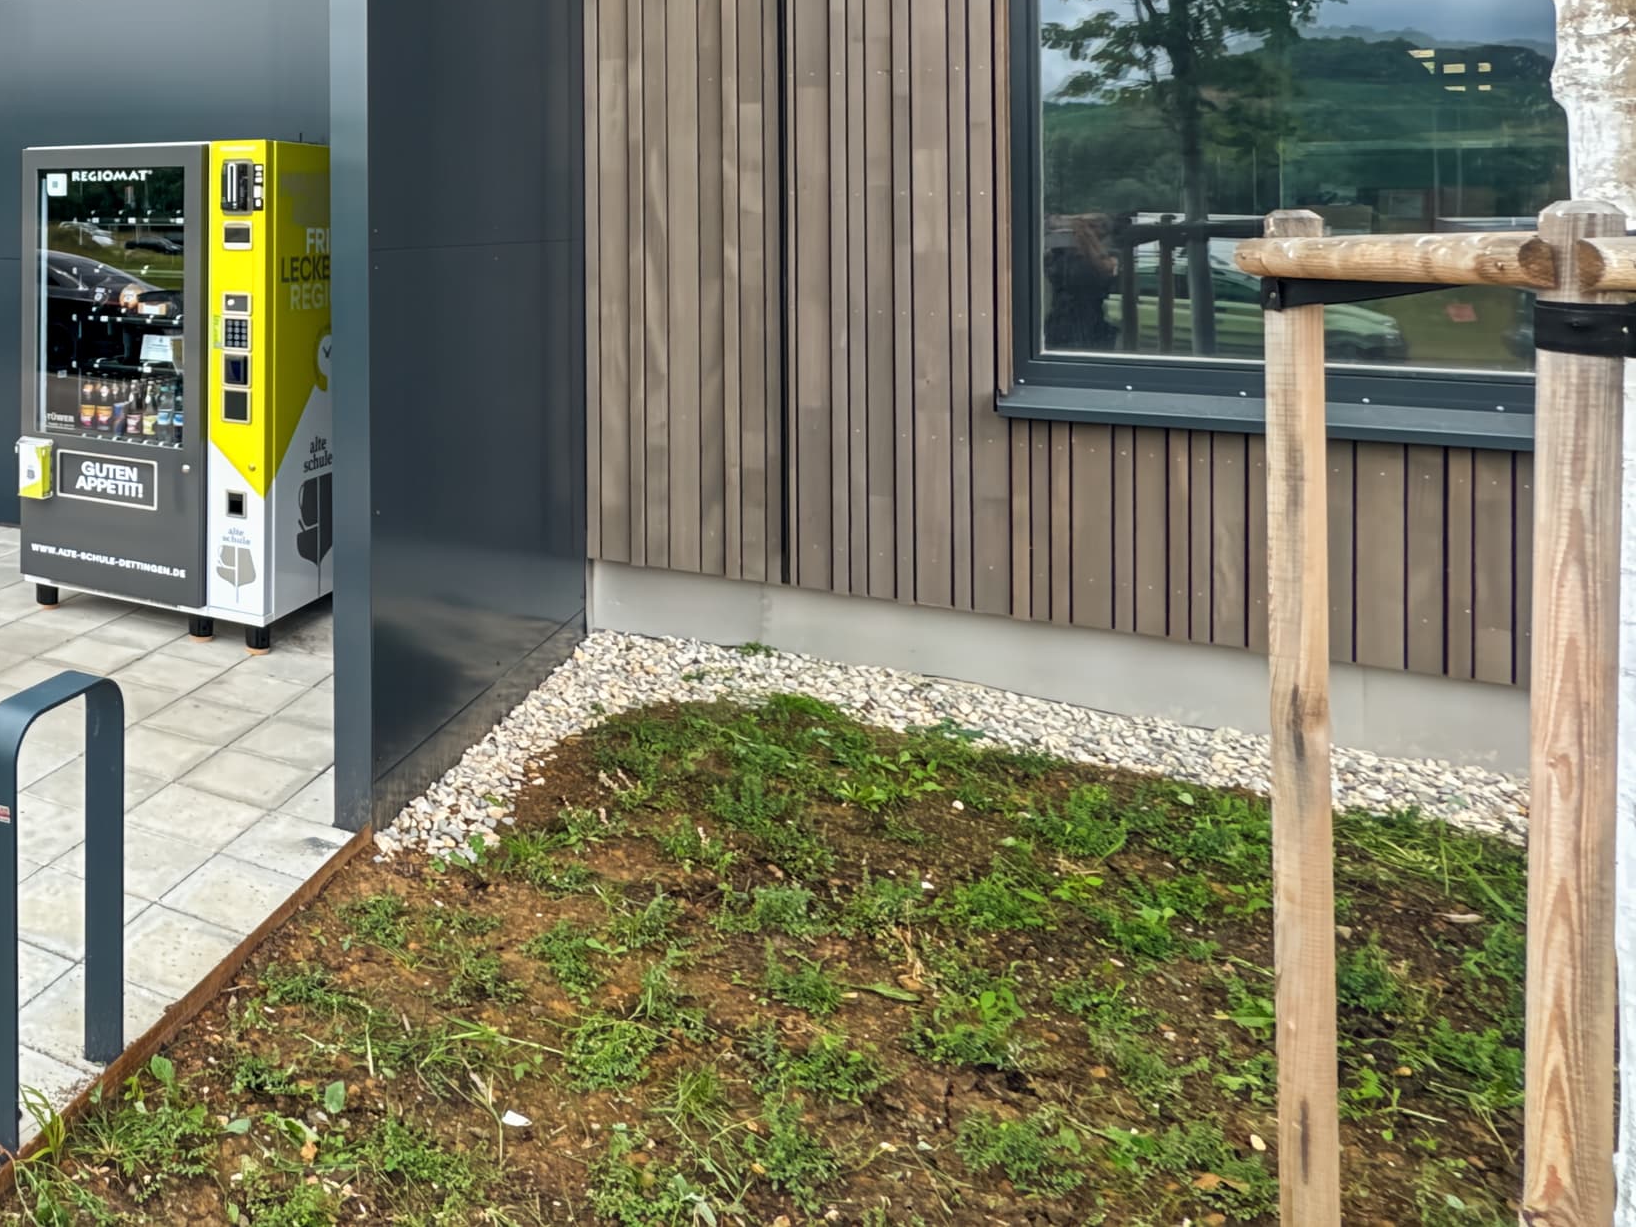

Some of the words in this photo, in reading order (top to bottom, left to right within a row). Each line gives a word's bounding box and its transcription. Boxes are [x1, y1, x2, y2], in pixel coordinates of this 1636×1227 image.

[310, 436, 327, 454] alte
[81, 461, 138, 482] GUTEN
[304, 452, 333, 473] schule
[75, 475, 143, 498] APPETIT!
[31, 543, 186, 579] WWW.ALTE-SCHULE-DETTINGEN.DE
